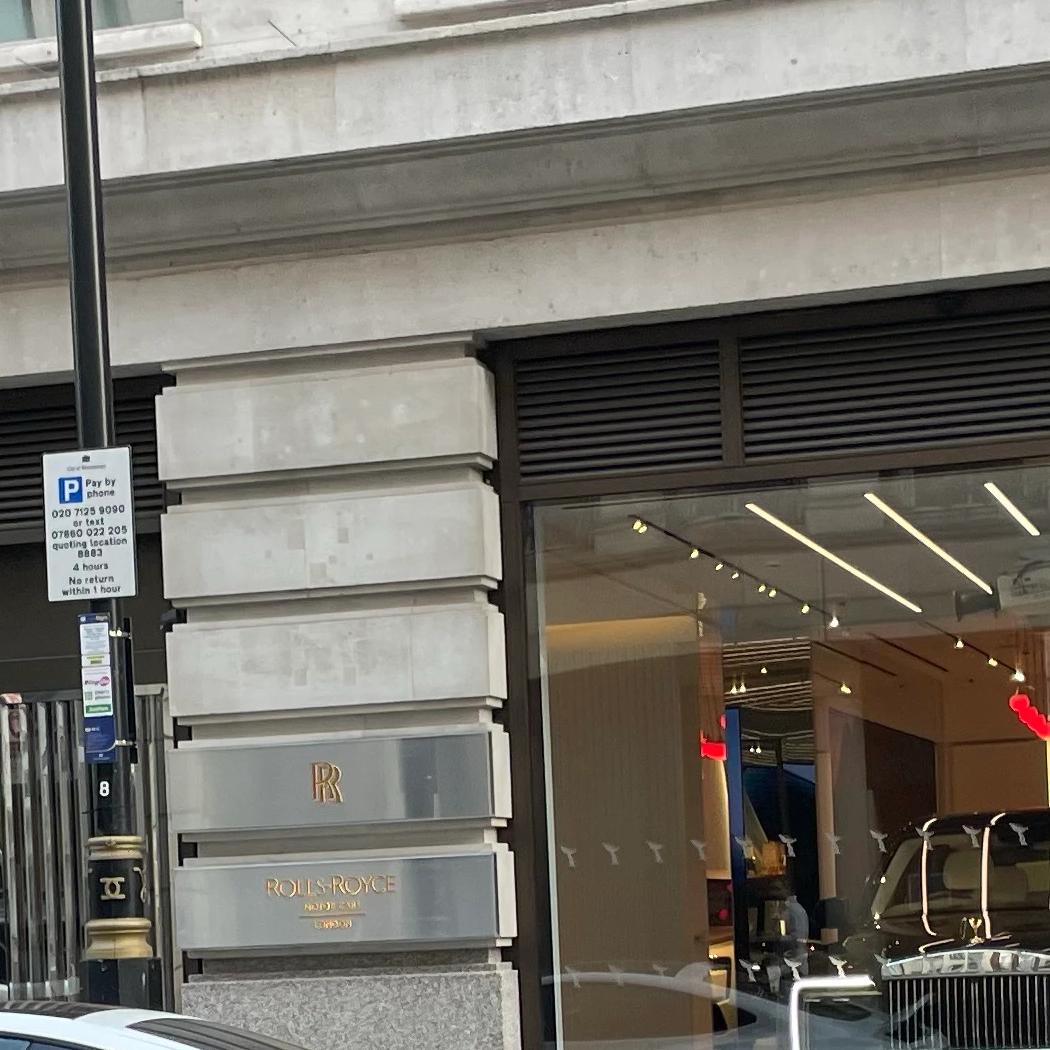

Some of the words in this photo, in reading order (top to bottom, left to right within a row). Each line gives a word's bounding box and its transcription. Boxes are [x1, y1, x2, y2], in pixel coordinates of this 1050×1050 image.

[85, 479, 103, 488] Pay
[105, 477, 116, 487] by
[64, 479, 79, 502] P
[86, 489, 115, 499] phone
[51, 508, 71, 518] 020
[74, 506, 96, 516] 7125
[99, 504, 125, 514] 9090
[86, 517, 104, 526] text
[86, 527, 105, 536] 022
[108, 525, 128, 535] 205
[52, 540, 87, 551] quoting
[90, 537, 128, 547] location
[72, 562, 80, 571] 4
[82, 562, 109, 571] hours
[68, 576, 82, 585] No
[85, 575, 115, 584] return
[62, 586, 90, 596] within
[100, 585, 121, 594] hour
[98, 780, 110, 797] 8
[265, 874, 397, 898] ROLLS-ROYCE
